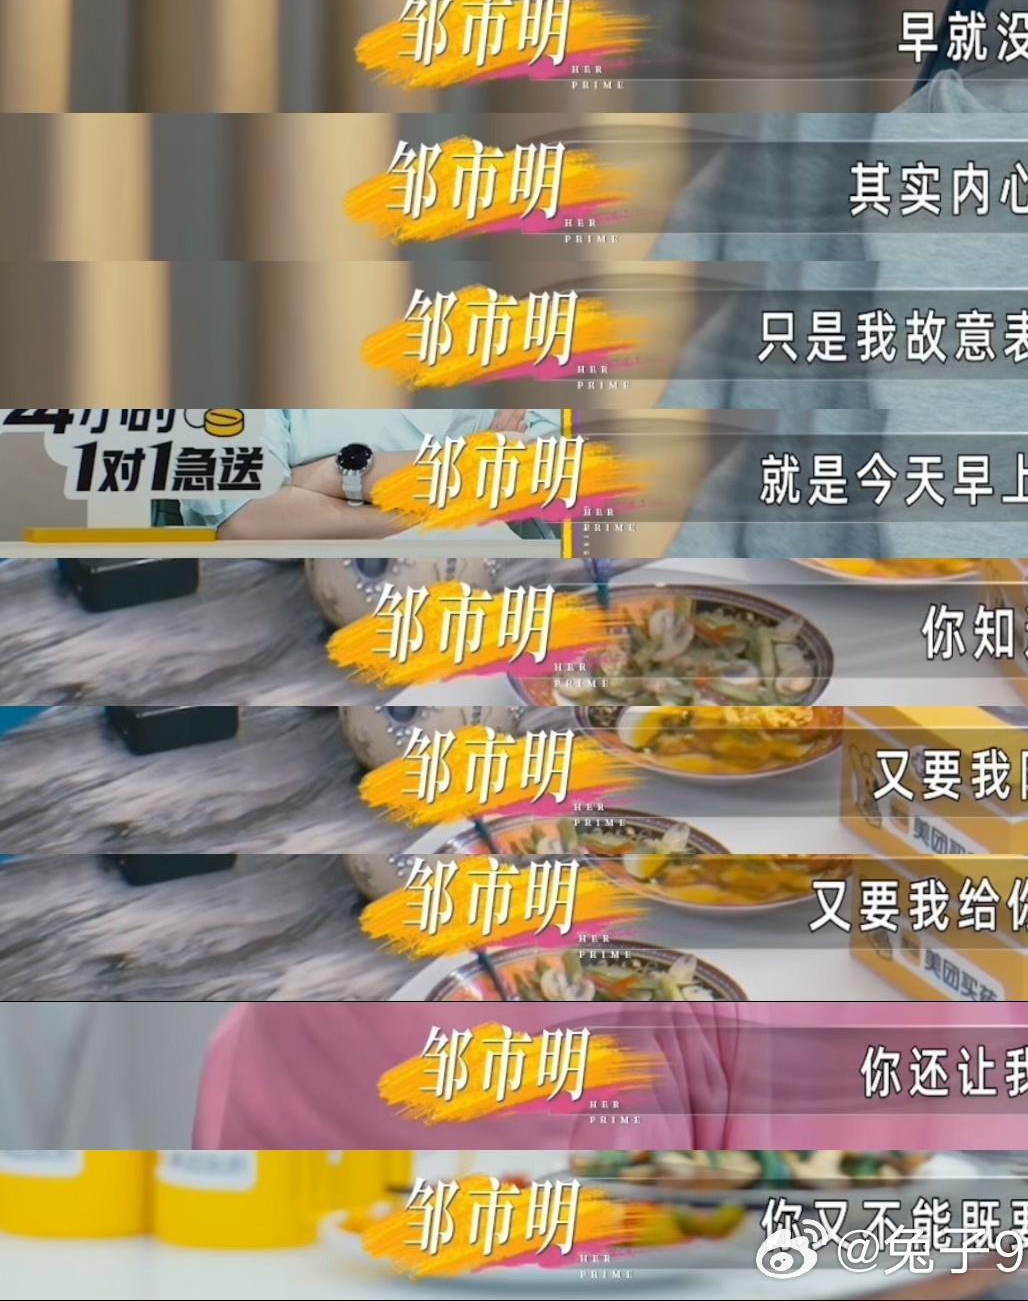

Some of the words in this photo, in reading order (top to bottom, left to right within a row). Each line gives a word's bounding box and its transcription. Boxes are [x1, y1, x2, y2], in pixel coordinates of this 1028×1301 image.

[74, 440, 263, 492] 1对1急送
[914, 817, 976, 854] 美团买
